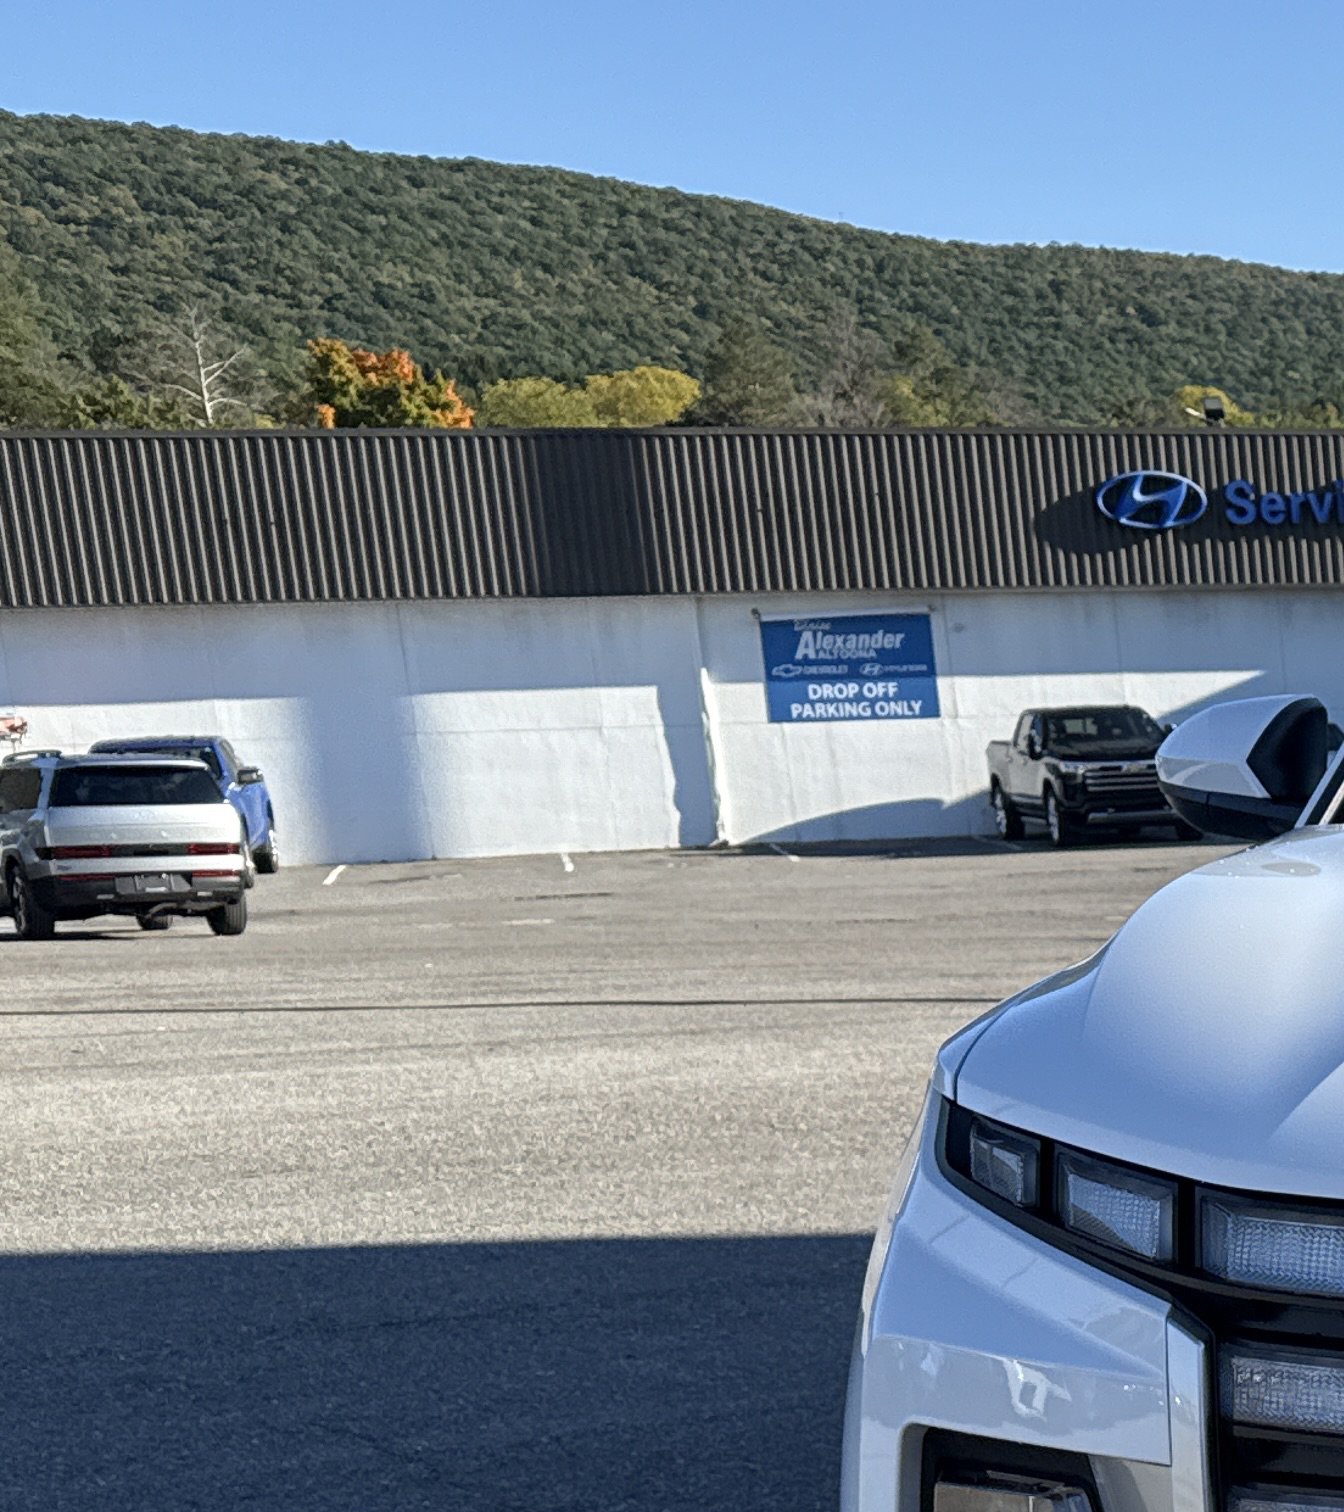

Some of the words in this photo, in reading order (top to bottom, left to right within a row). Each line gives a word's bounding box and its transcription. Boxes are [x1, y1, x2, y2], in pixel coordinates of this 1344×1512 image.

[795, 629, 905, 660] Alexander
[807, 684, 859, 700] DROP
[862, 681, 899, 698] OFF
[790, 702, 870, 719] PARKING
[874, 700, 923, 717] ONLY
